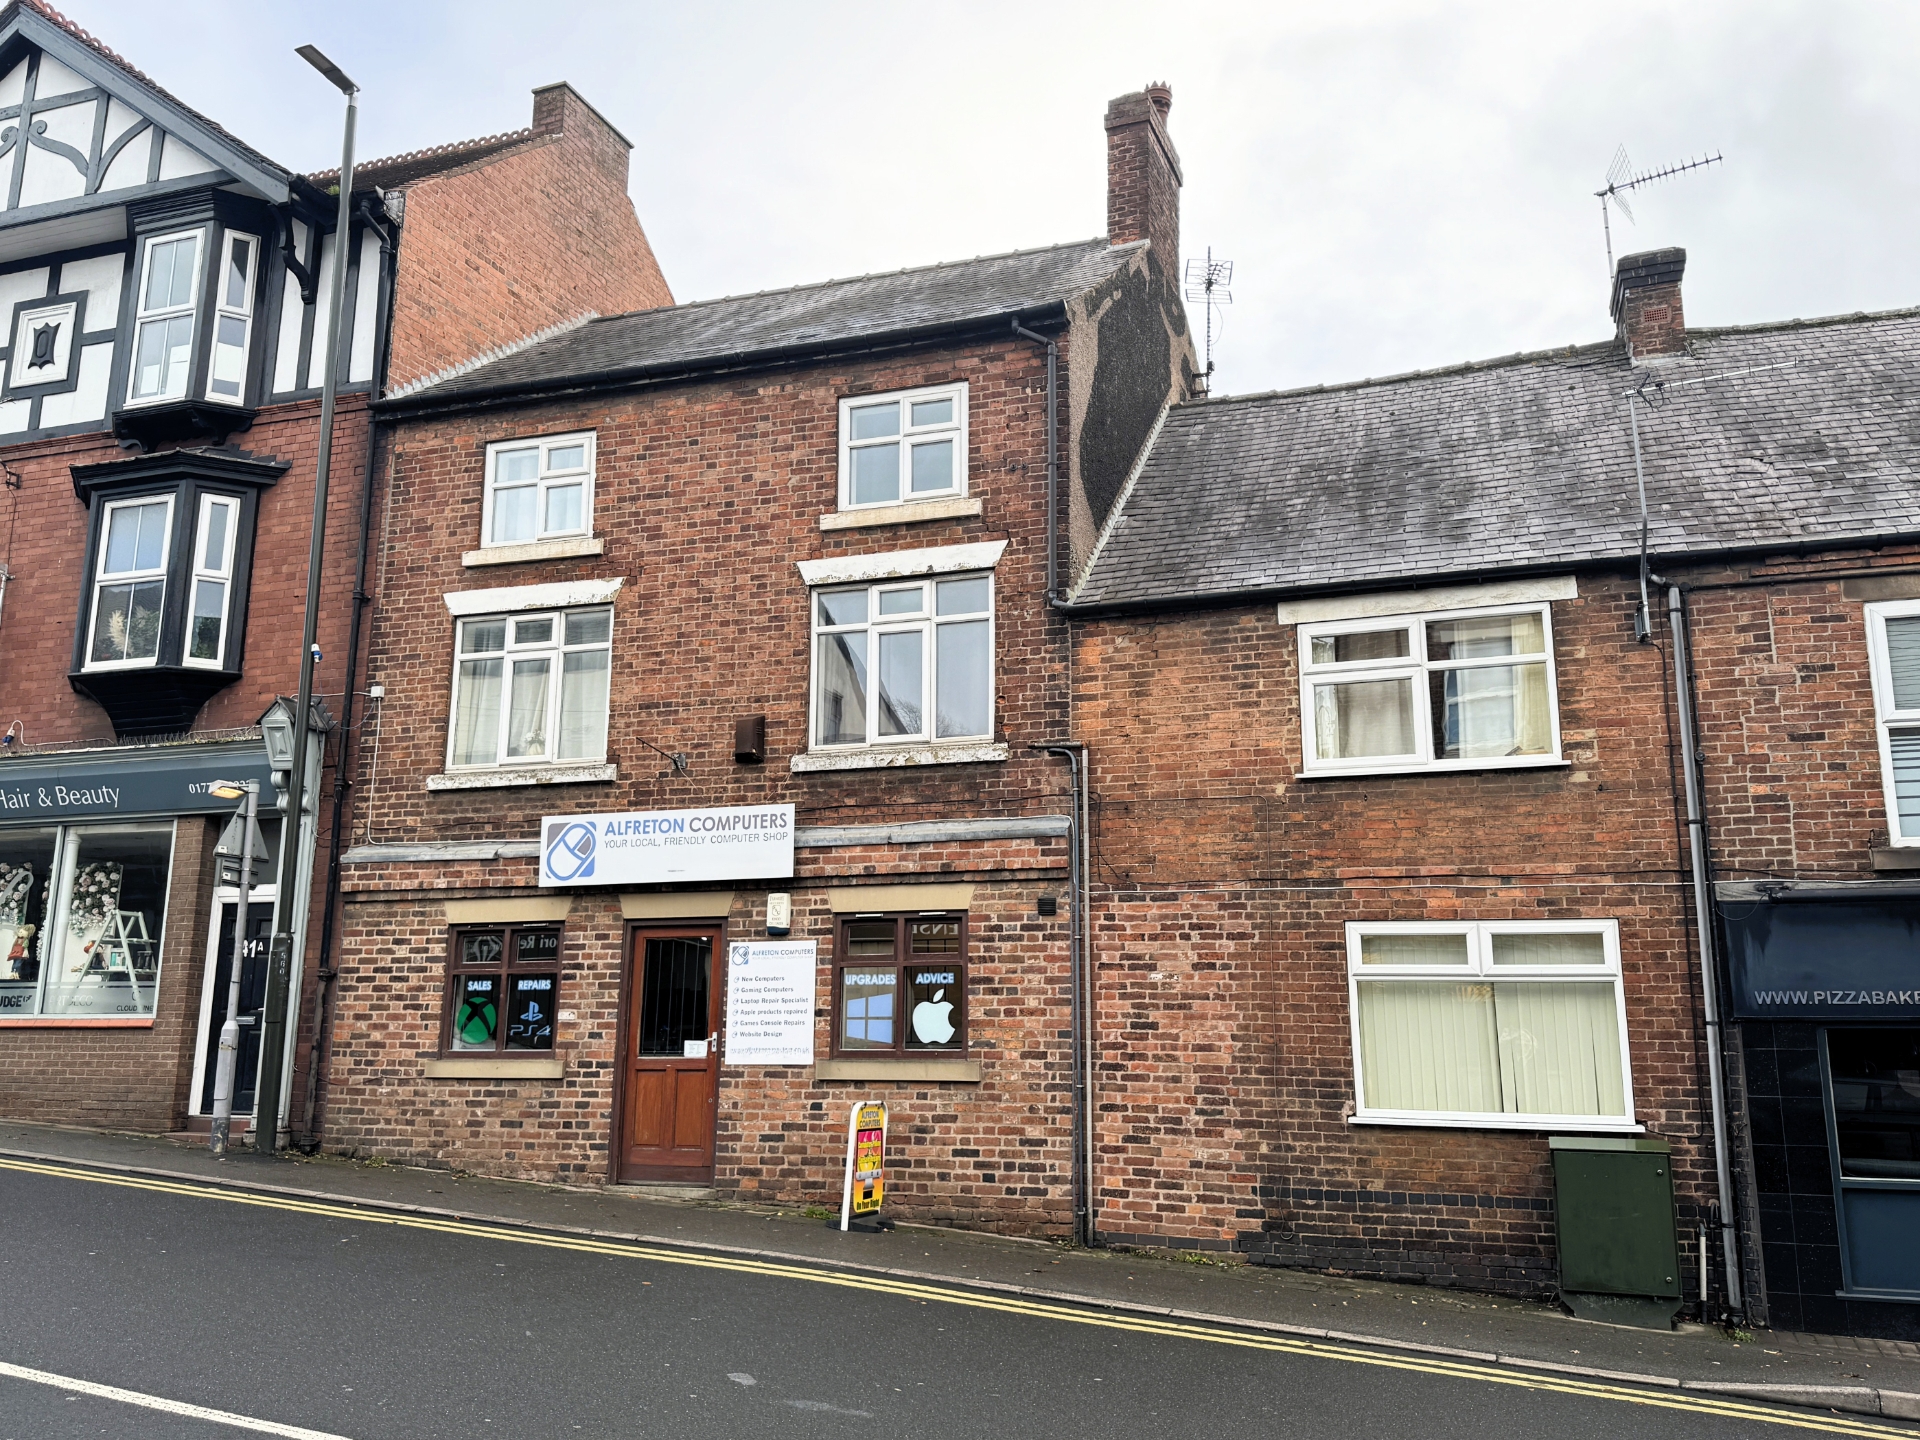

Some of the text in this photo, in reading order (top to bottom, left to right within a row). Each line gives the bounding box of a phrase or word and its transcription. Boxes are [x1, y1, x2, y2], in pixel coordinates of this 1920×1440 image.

[188, 782, 211, 794] 0177
[38, 787, 53, 807] &
[55, 785, 119, 808] Beauty
[604, 813, 787, 837] ALFRETON COMPUTERS
[604, 831, 788, 848] YOUR LOCAL, FRIENDLY COMPUTER SHOP
[845, 973, 897, 985] UPGRADES
[915, 972, 955, 984] ADVICE
[467, 980, 492, 991] SALES
[517, 979, 552, 991] REPAIRS
[1754, 990, 1920, 1005] WWW.PIZZABAKE
[510, 1024, 552, 1036] PS4
